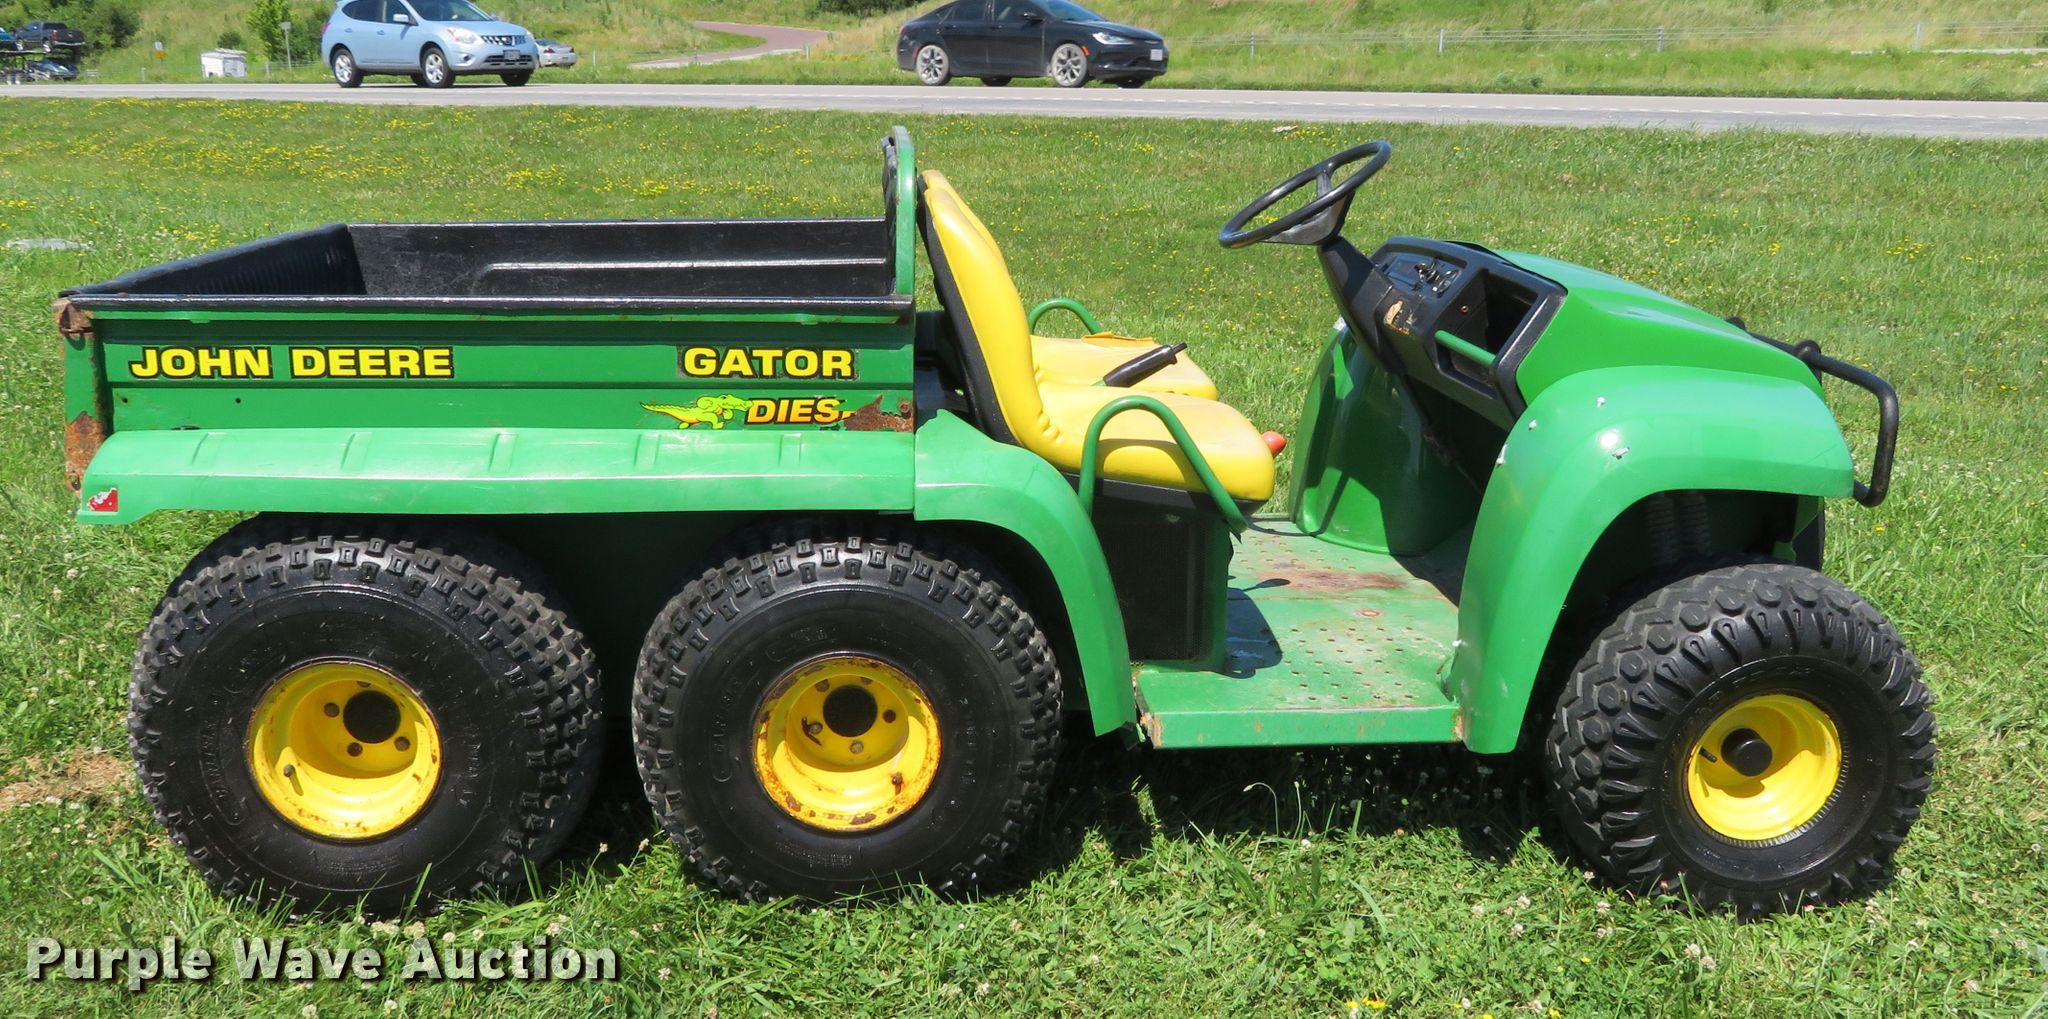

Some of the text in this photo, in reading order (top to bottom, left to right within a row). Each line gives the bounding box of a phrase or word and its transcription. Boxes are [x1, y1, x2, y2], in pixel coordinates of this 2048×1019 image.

[130, 347, 453, 377] JOHN DEERE
[682, 346, 854, 378] GATOR
[746, 398, 853, 424] DIES
